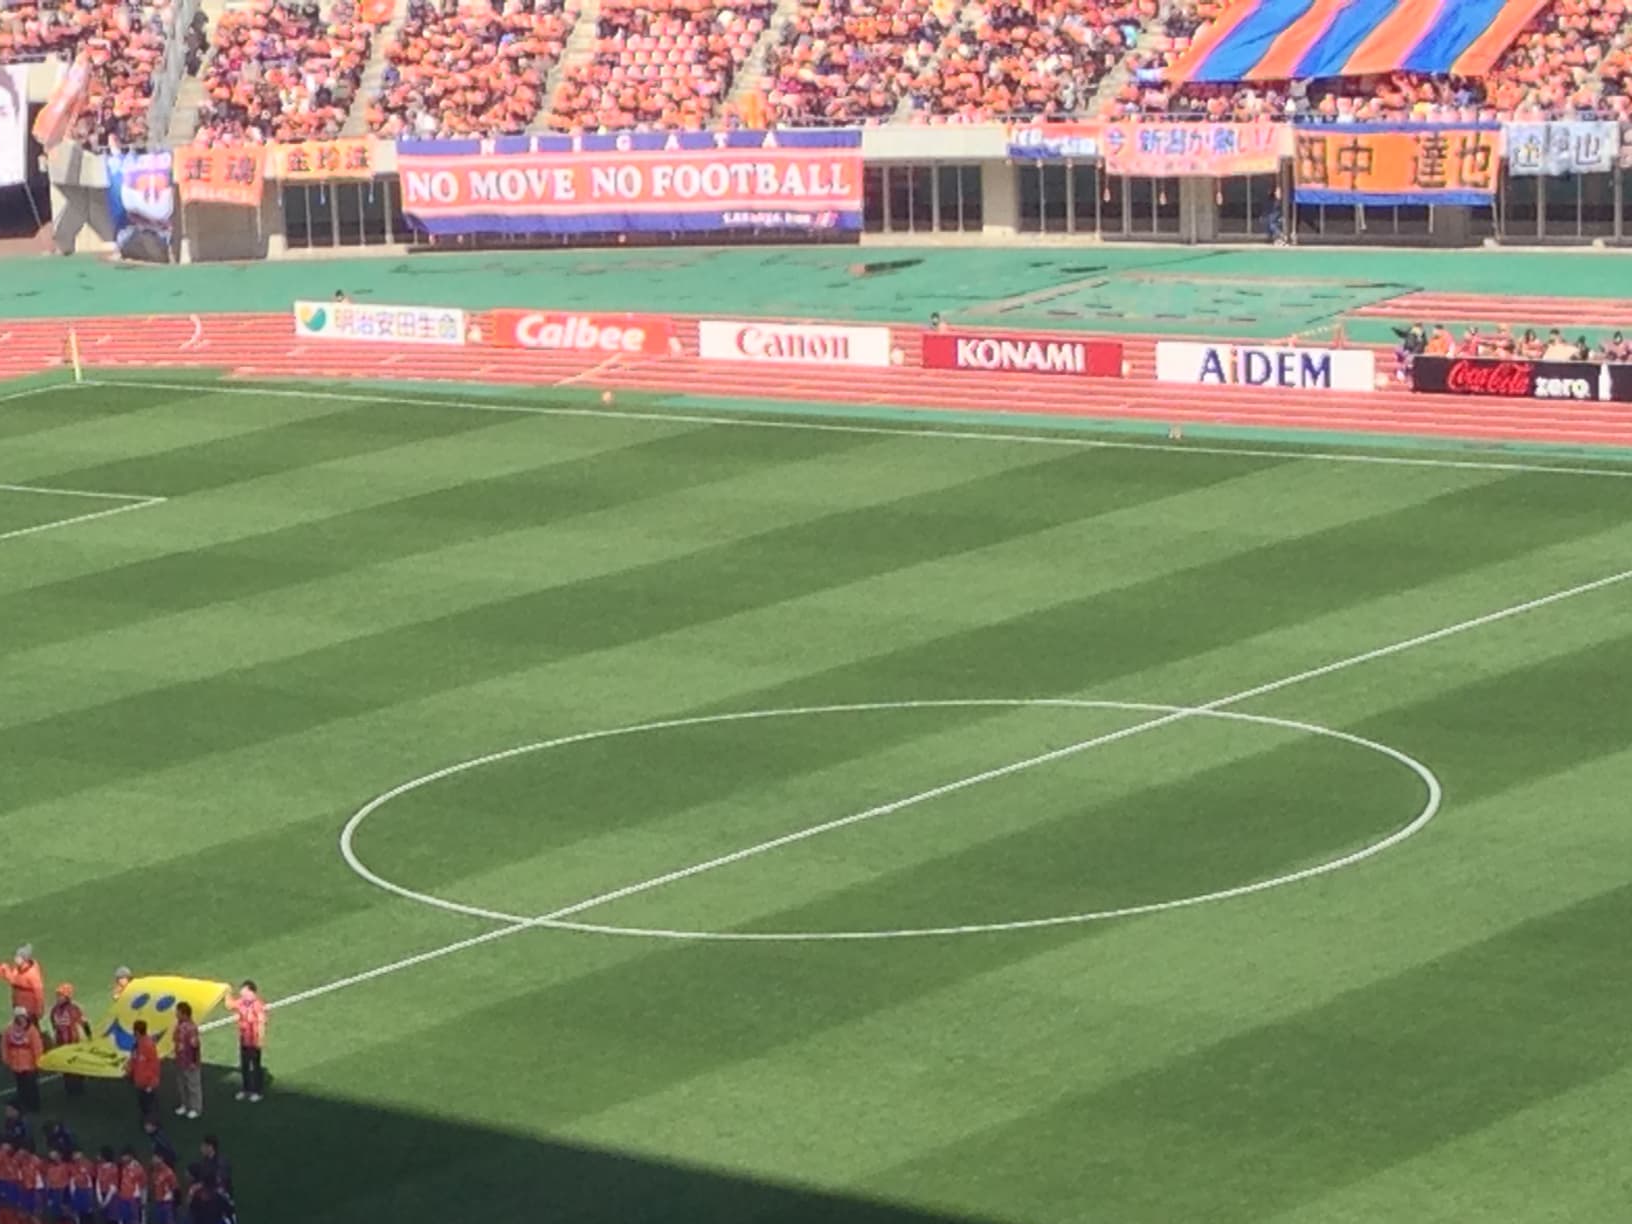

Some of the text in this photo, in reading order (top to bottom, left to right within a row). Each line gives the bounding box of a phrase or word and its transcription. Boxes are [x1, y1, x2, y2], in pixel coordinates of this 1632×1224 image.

[1298, 131, 1492, 191] 田中 達也
[407, 161, 851, 203] NO MOVE NO FOOTBALL
[334, 304, 459, 339] 明治安田生命
[515, 314, 646, 353] Calbee
[736, 328, 851, 361] Canon
[956, 338, 1086, 374] KONAMI
